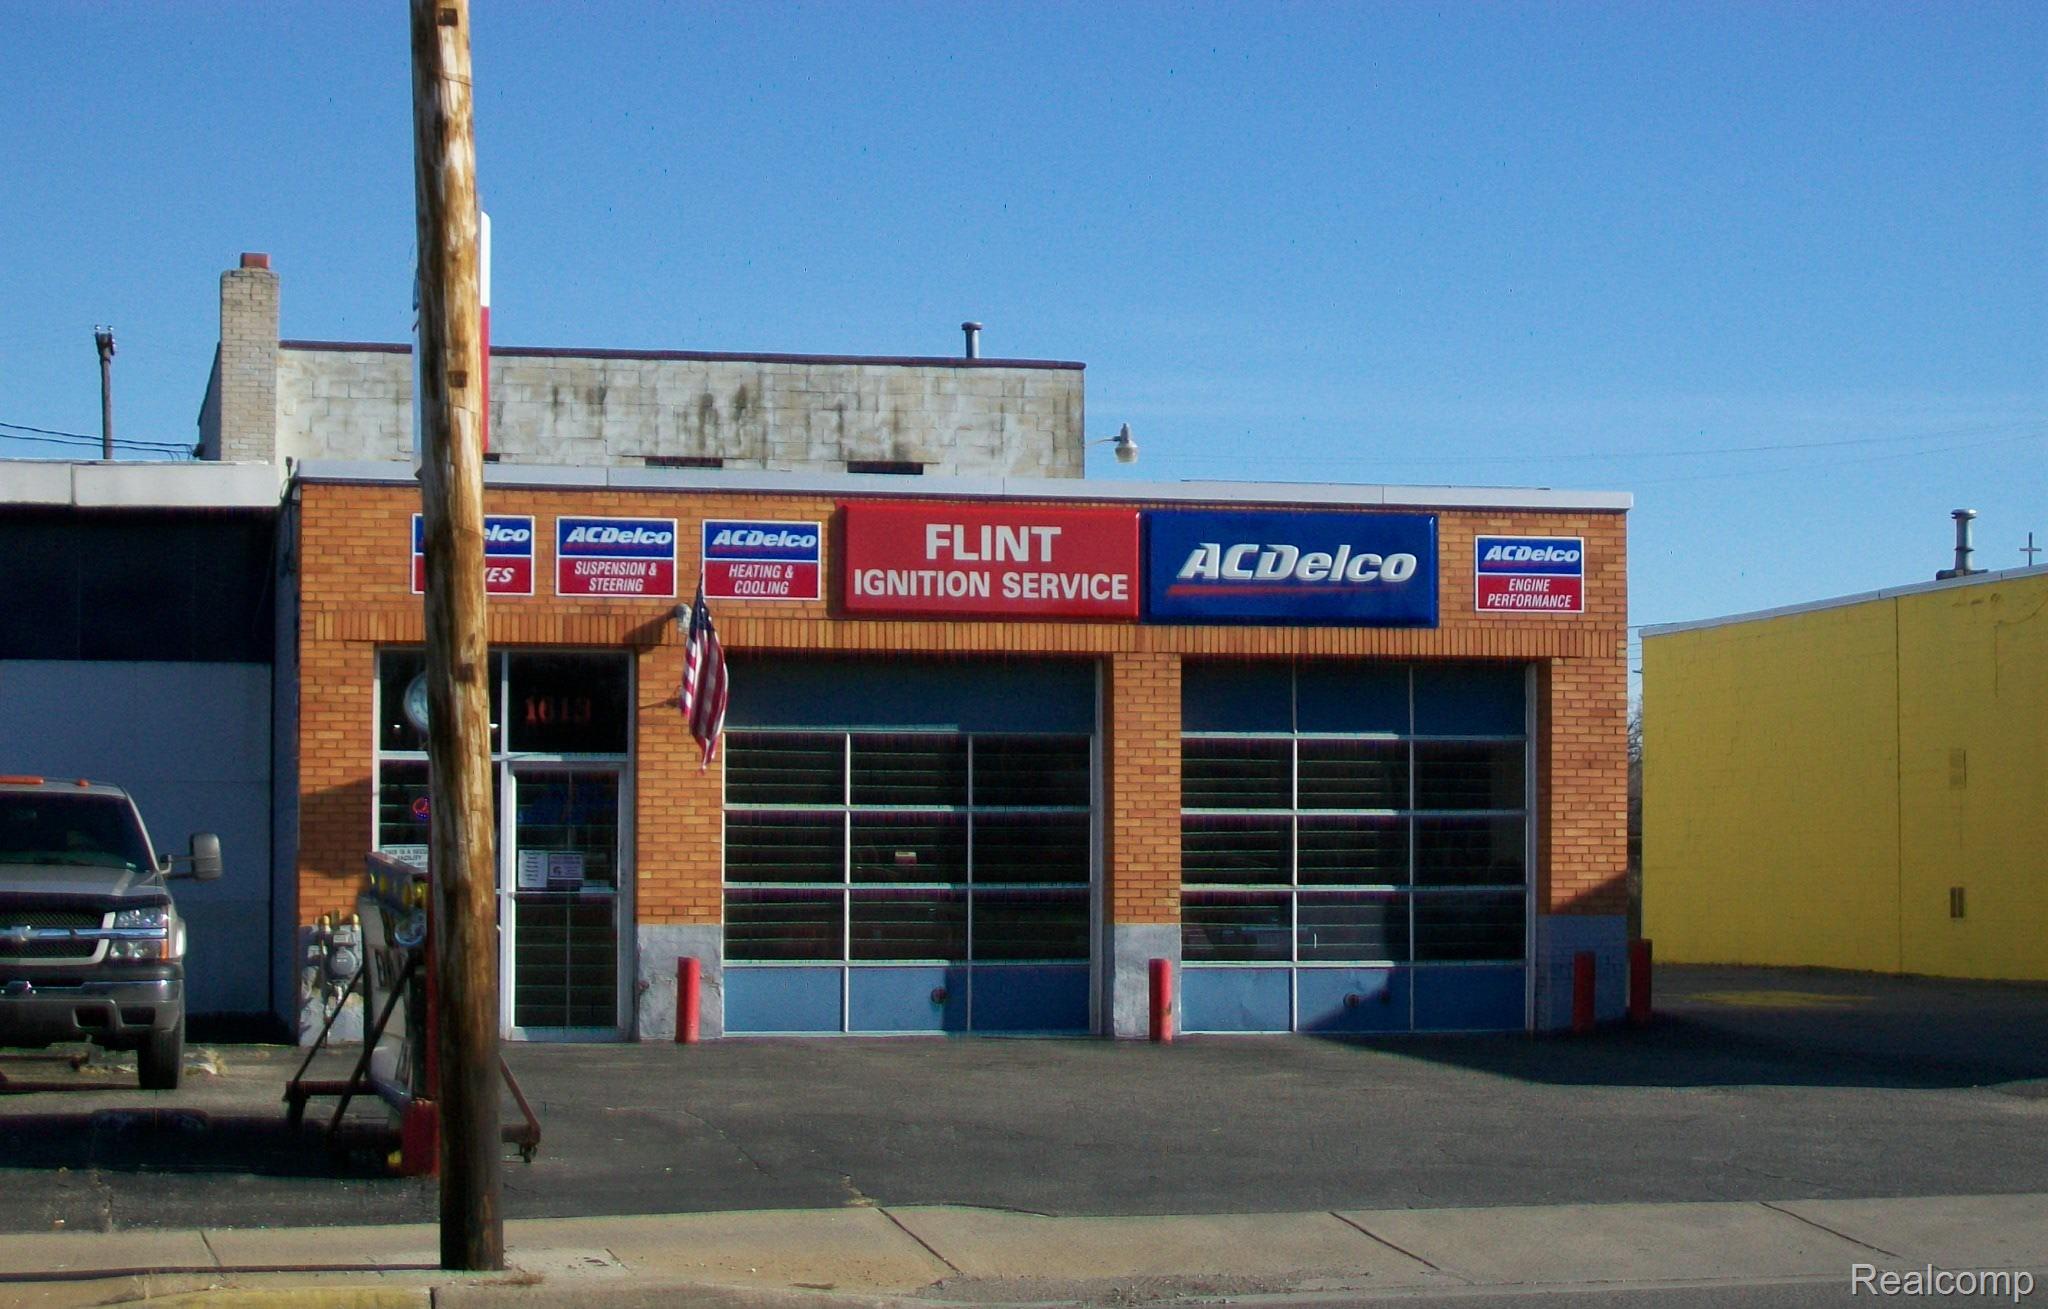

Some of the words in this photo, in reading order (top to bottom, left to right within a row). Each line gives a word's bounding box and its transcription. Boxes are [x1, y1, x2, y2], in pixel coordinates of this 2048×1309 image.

[566, 526, 672, 544] ACDelco
[712, 529, 816, 547] ACDelco
[926, 523, 1061, 562] FLINT
[1484, 545, 1580, 562] ACDelco
[574, 561, 646, 576] SUSPENSION
[648, 562, 657, 576] &
[1177, 543, 1417, 583] ACDelco
[728, 564, 782, 578] HEATING
[785, 565, 794, 579] &
[589, 577, 645, 592] STEERING
[734, 580, 789, 595] COOLING
[854, 569, 990, 598] IGNITION
[1002, 572, 1129, 600] SERVICE
[1508, 578, 1551, 592] ENGINE
[1487, 593, 1573, 608] PERFORMANCE
